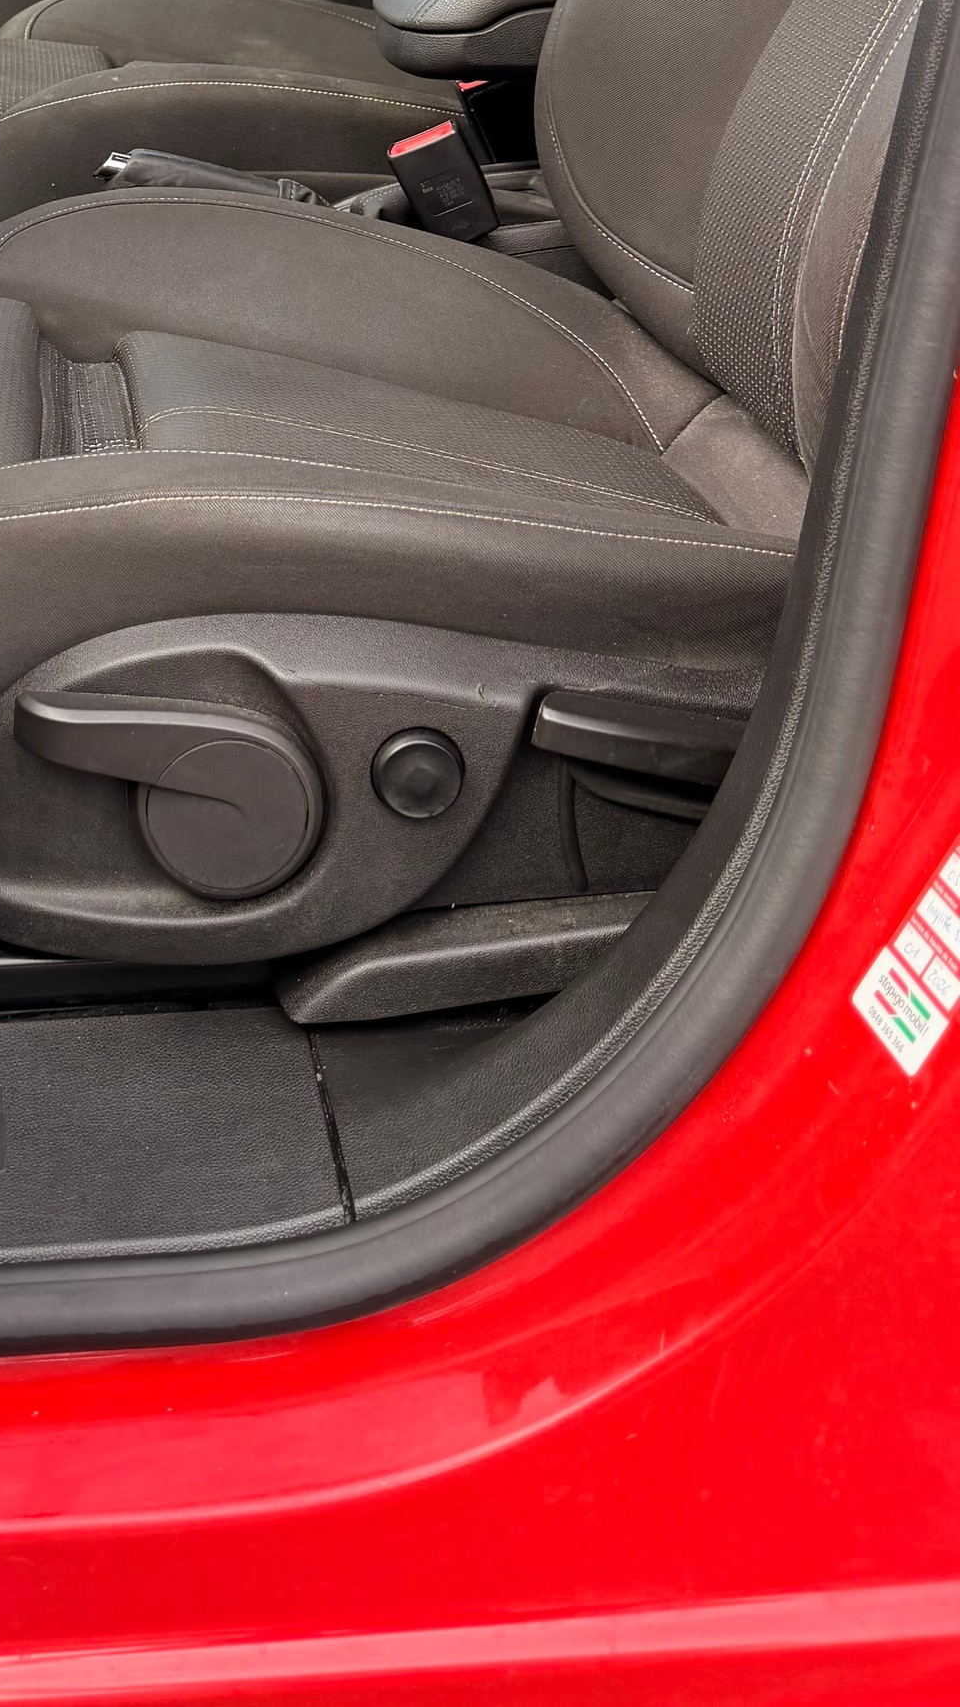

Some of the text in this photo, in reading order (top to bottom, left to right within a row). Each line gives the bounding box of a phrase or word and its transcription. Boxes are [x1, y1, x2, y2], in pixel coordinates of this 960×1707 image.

[868, 1005, 905, 1054] 0848 365 366
